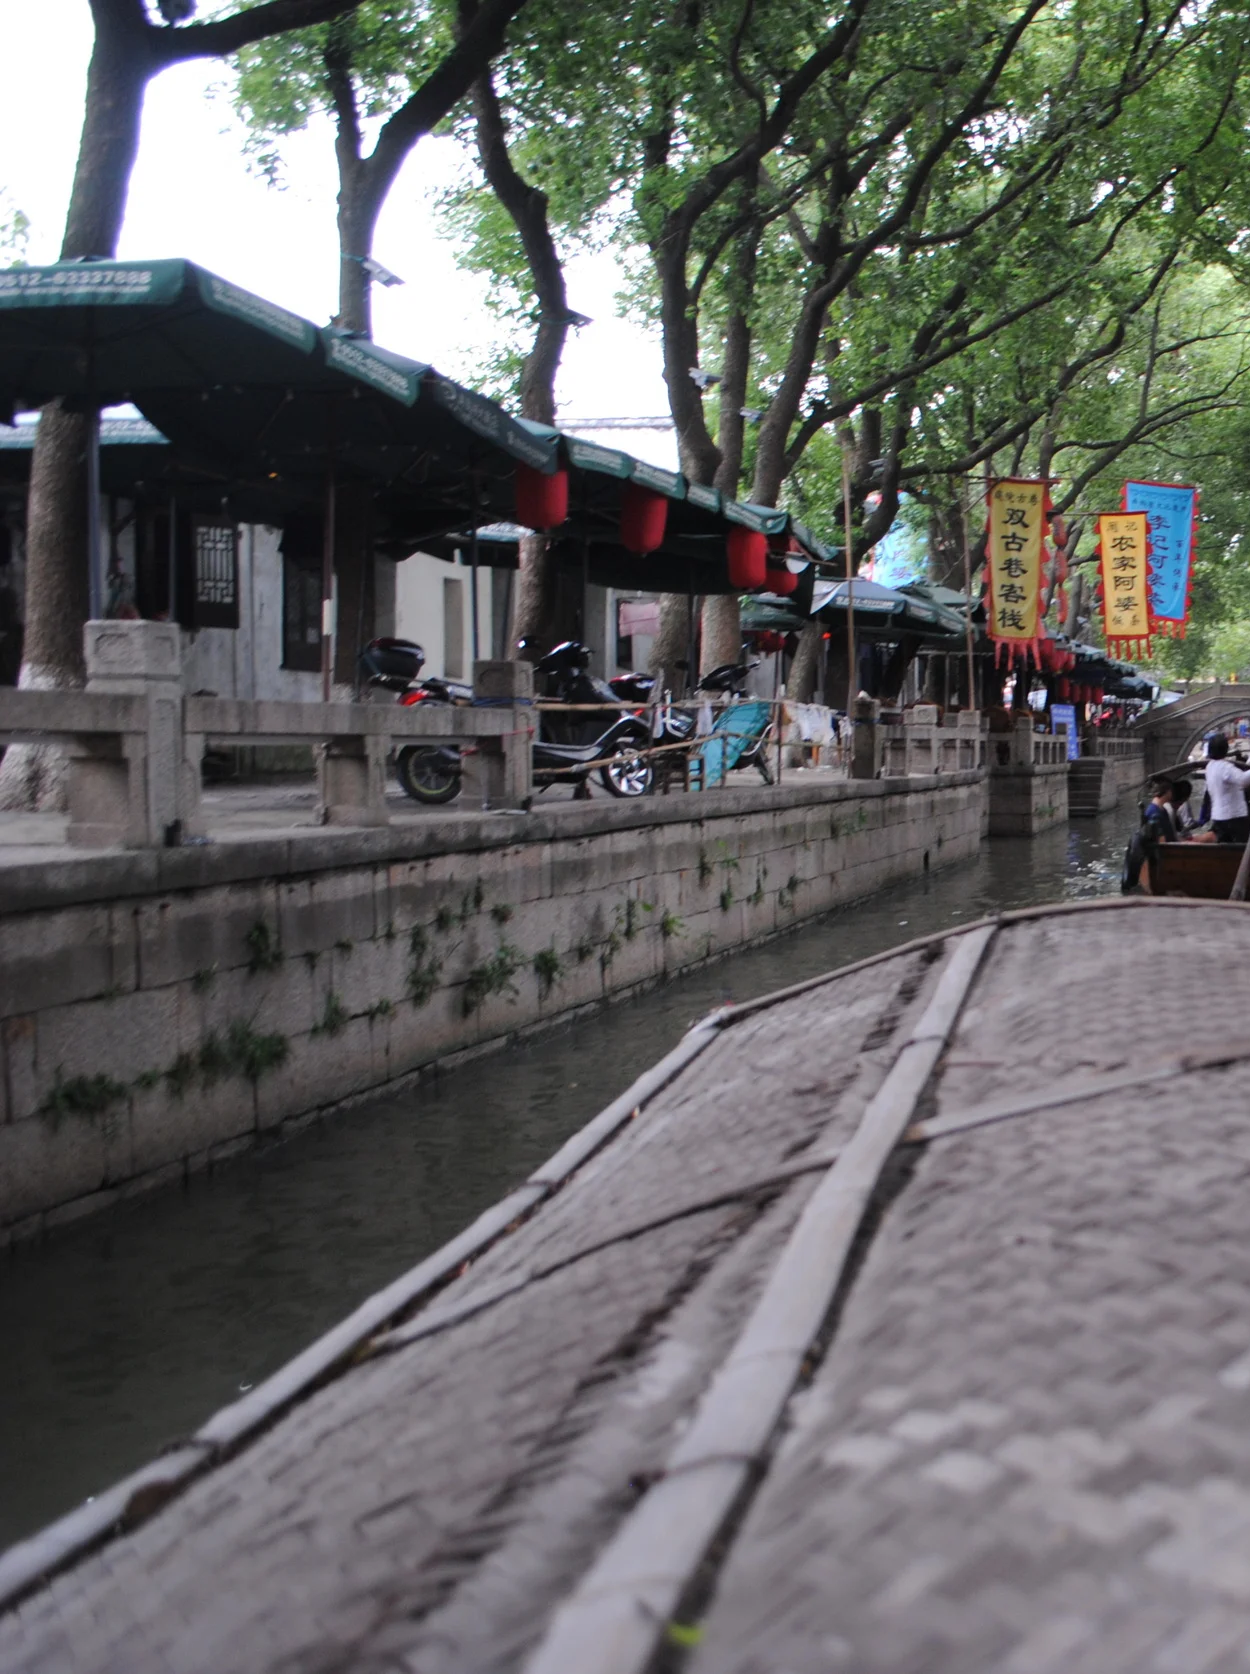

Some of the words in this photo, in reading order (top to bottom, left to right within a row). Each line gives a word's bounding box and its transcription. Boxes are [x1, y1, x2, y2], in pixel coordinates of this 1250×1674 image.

[998, 507, 1031, 631] 双古巷客栈
[1110, 535, 1139, 612] 农家阿婆
